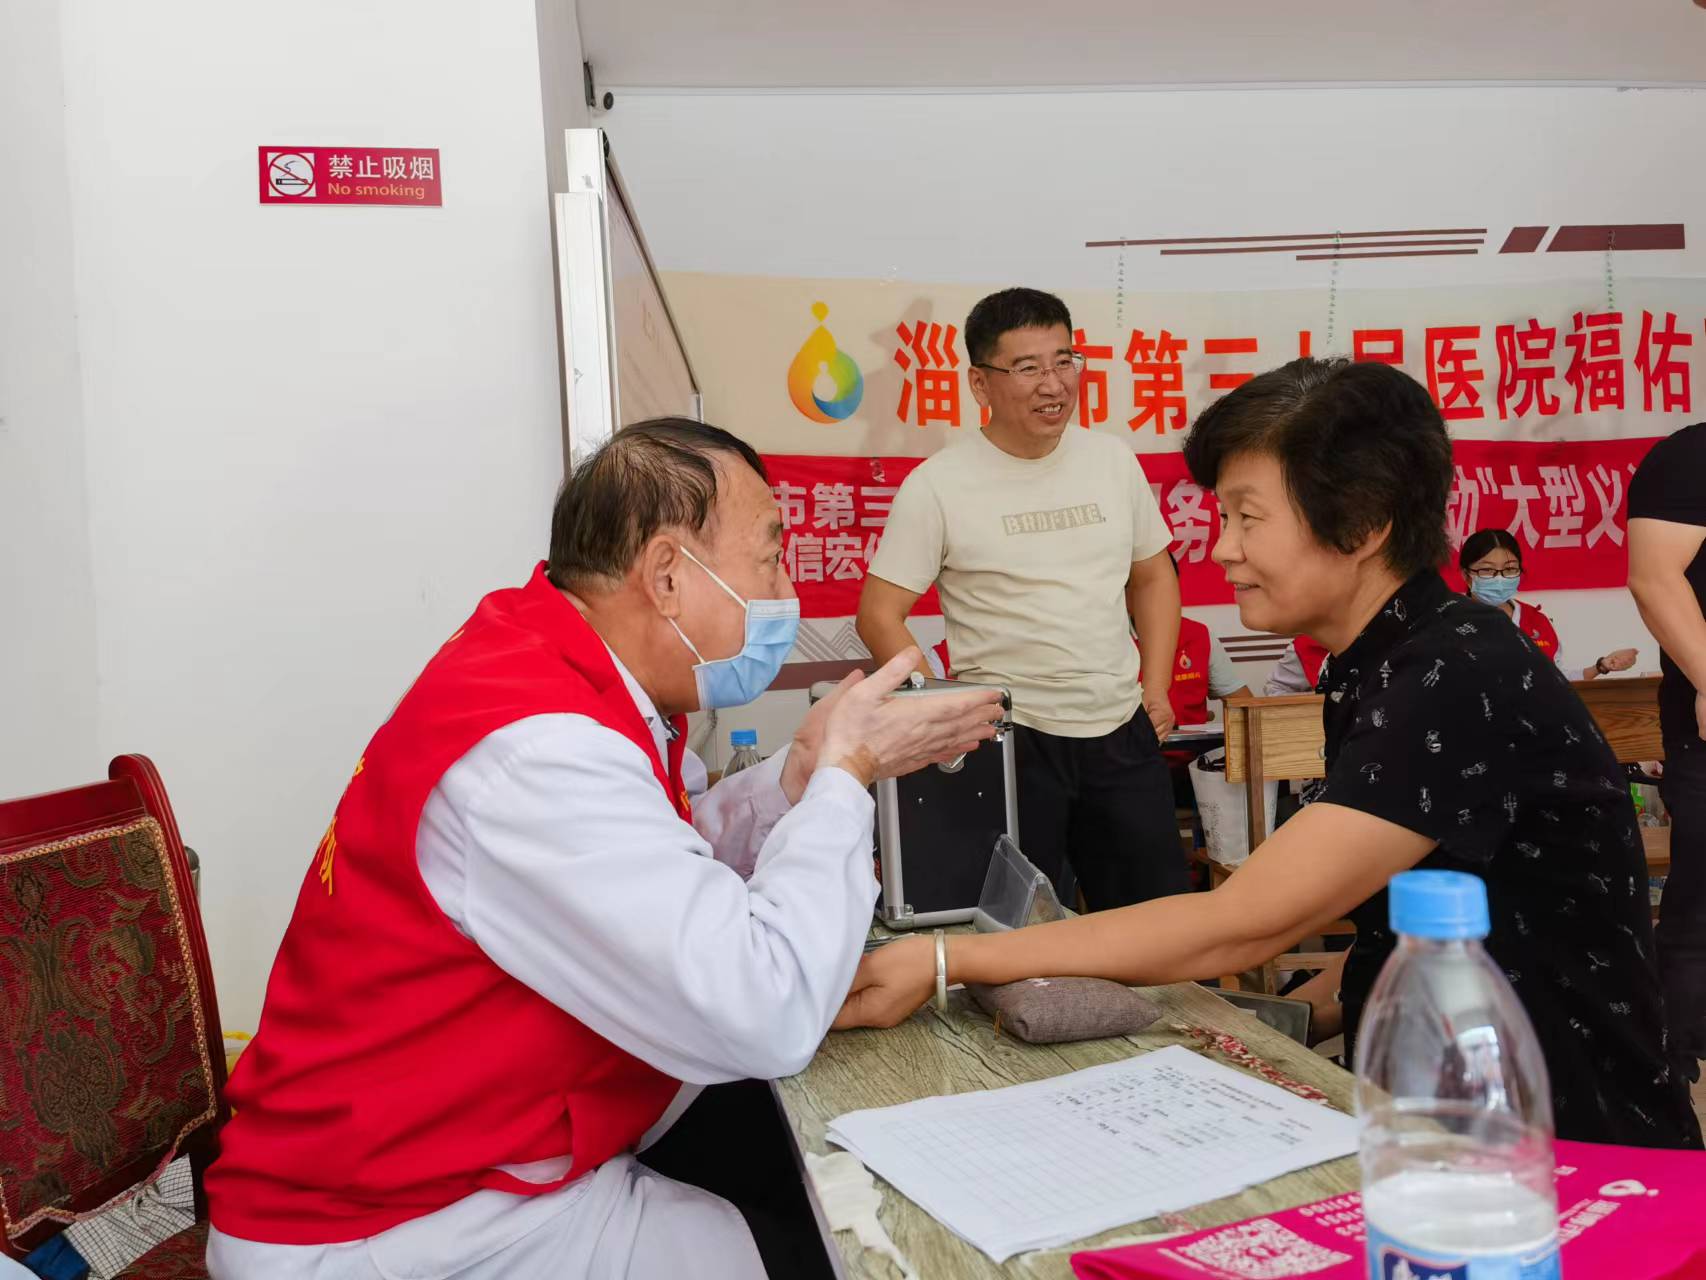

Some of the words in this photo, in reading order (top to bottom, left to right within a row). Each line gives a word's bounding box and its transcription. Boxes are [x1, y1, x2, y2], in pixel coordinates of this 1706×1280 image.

[328, 154, 434, 180] 禁止吸烟
[328, 183, 350, 196] No
[355, 184, 425, 200] smoking
[786, 532, 882, 582] 信宏
